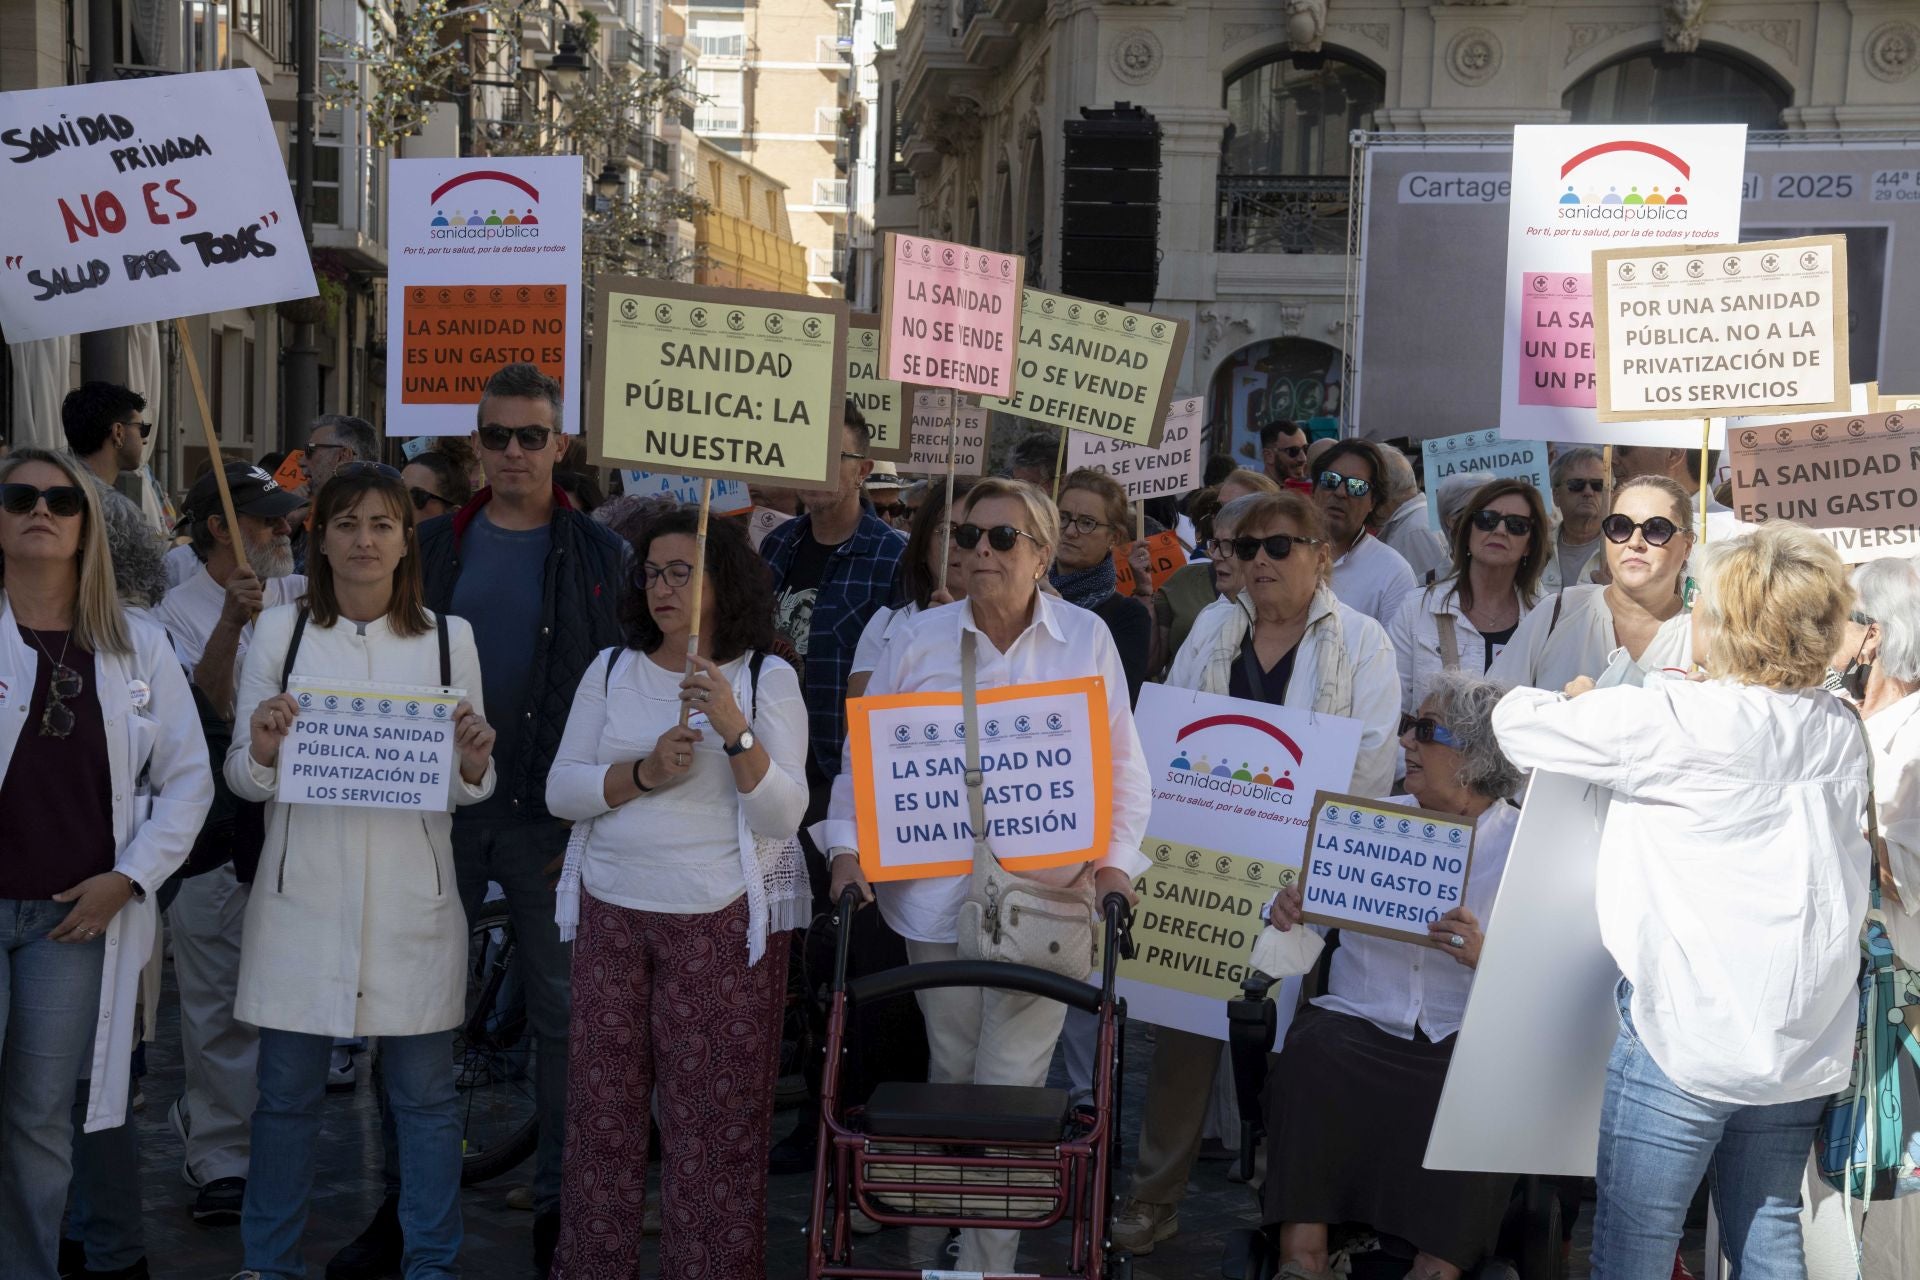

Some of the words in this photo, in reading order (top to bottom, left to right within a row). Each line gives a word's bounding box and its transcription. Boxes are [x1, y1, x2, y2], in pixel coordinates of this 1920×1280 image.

[1, 114, 135, 163] SANIDAD
[110, 134, 212, 174] PRIVADA
[1777, 175, 1853, 199] 2025
[1875, 190, 1892, 200] 29
[58, 190, 127, 243] NO
[142, 179, 198, 224] ES
[1558, 204, 1688, 222] sanidadpública
[430, 224, 539, 240] sanidadpública
[1527, 226, 1542, 236] Por
[1554, 229, 1570, 238] por
[1572, 228, 1580, 236] tu
[1584, 228, 1611, 238] salud,
[1613, 229, 1630, 239] por
[1631, 228, 1639, 237] la
[1642, 228, 1654, 238] de
[1656, 228, 1682, 238] todas
[1684, 230, 1690, 239] y
[1692, 229, 1718, 238] todos
[452, 246, 476, 254] salud,
[908, 280, 927, 302] LA
[931, 284, 1002, 315] SANIDAD
[1620, 300, 1662, 318] POR
[1667, 297, 1715, 315] UNA
[1720, 290, 1821, 313] SANIDAD
[407, 320, 432, 336] LA
[436, 318, 526, 336] SANIDAD
[532, 318, 563, 334] NO
[1536, 311, 1562, 328] LA
[1626, 324, 1720, 346] PÚBLICA.
[1727, 323, 1760, 342] NO
[1766, 322, 1782, 340] A
[1788, 321, 1816, 338] LA
[902, 316, 927, 339] NO
[932, 322, 954, 342] SE
[958, 324, 1004, 352] VENDE
[1018, 326, 1042, 348] LA
[1048, 333, 1148, 370] SANIDAD
[407, 348, 428, 364] ES
[434, 348, 462, 364] UN
[470, 347, 534, 364] GASTO
[542, 347, 562, 363] ES
[660, 341, 792, 378] SANIDAD
[1525, 341, 1556, 358] UN
[1623, 350, 1786, 374] PRIVATIZACIÓN
[1792, 350, 1820, 368] DE
[406, 376, 448, 392] UNA
[903, 354, 920, 376] SE
[926, 357, 1000, 387] DEFENDE
[1042, 365, 1068, 386] SE
[1074, 370, 1148, 404] VENDE
[1535, 372, 1566, 388] UN
[625, 379, 762, 420] PÚBLICA:
[773, 398, 811, 426] LA
[1644, 385, 1682, 403] LOS
[1688, 380, 1798, 402] SERVICIOS
[964, 418, 978, 428] ES
[1029, 394, 1136, 435] DEFIENDE
[646, 429, 786, 468] NUESTRA
[963, 436, 983, 447] NO
[1084, 440, 1106, 454] LA
[1112, 460, 1130, 476] SE
[1134, 448, 1192, 471] VENDE
[1437, 462, 1456, 478] LA
[1460, 450, 1534, 472] SANIDAD
[1736, 468, 1770, 489] LA
[1776, 454, 1901, 486] SANIDAD
[1740, 504, 1768, 524] ES
[1776, 499, 1817, 520] UN
[1826, 488, 1918, 515] GASTO
[295, 720, 328, 735] POR
[334, 724, 368, 738] UNA
[374, 726, 445, 743] SANIDAD
[298, 740, 370, 760] PÚBLICA.
[375, 748, 400, 761] NO
[404, 750, 414, 762] A
[419, 751, 438, 764] LA
[892, 760, 920, 780] LA
[926, 752, 1029, 778] SANDAD
[1036, 748, 1072, 768] NO
[292, 763, 414, 784] PRIVATIZACIÓN
[419, 772, 440, 784] DE
[1166, 770, 1293, 805] sanidadpública
[306, 786, 336, 799] LOS
[341, 788, 422, 804] SERVICIOS
[894, 792, 918, 812] ES
[926, 790, 960, 809] UN
[967, 783, 1042, 806] ASTO
[1050, 780, 1074, 800] ES
[1158, 790, 1175, 800] por
[1176, 794, 1186, 803] tu
[1187, 796, 1214, 810] salud,
[1216, 803, 1232, 814] por
[1234, 804, 1244, 814] la
[1244, 807, 1256, 817] de
[1258, 810, 1284, 823] todas
[1286, 816, 1291, 825] y
[896, 822, 948, 844] UNA
[1317, 834, 1338, 852] LA
[1344, 838, 1426, 868] SANIDAD
[1432, 855, 1462, 874] NO
[1312, 860, 1332, 876] ES
[1338, 864, 1365, 884] UN
[1370, 872, 1432, 896] GASTO
[1437, 884, 1458, 902] ES
[1154, 880, 1253, 916] SANIDAD
[1308, 886, 1347, 908] UNA
[1352, 895, 1444, 924] INVERSIÓ
[1142, 912, 1245, 949] DERECHO
[1146, 945, 1260, 983] PRIVILEGI
